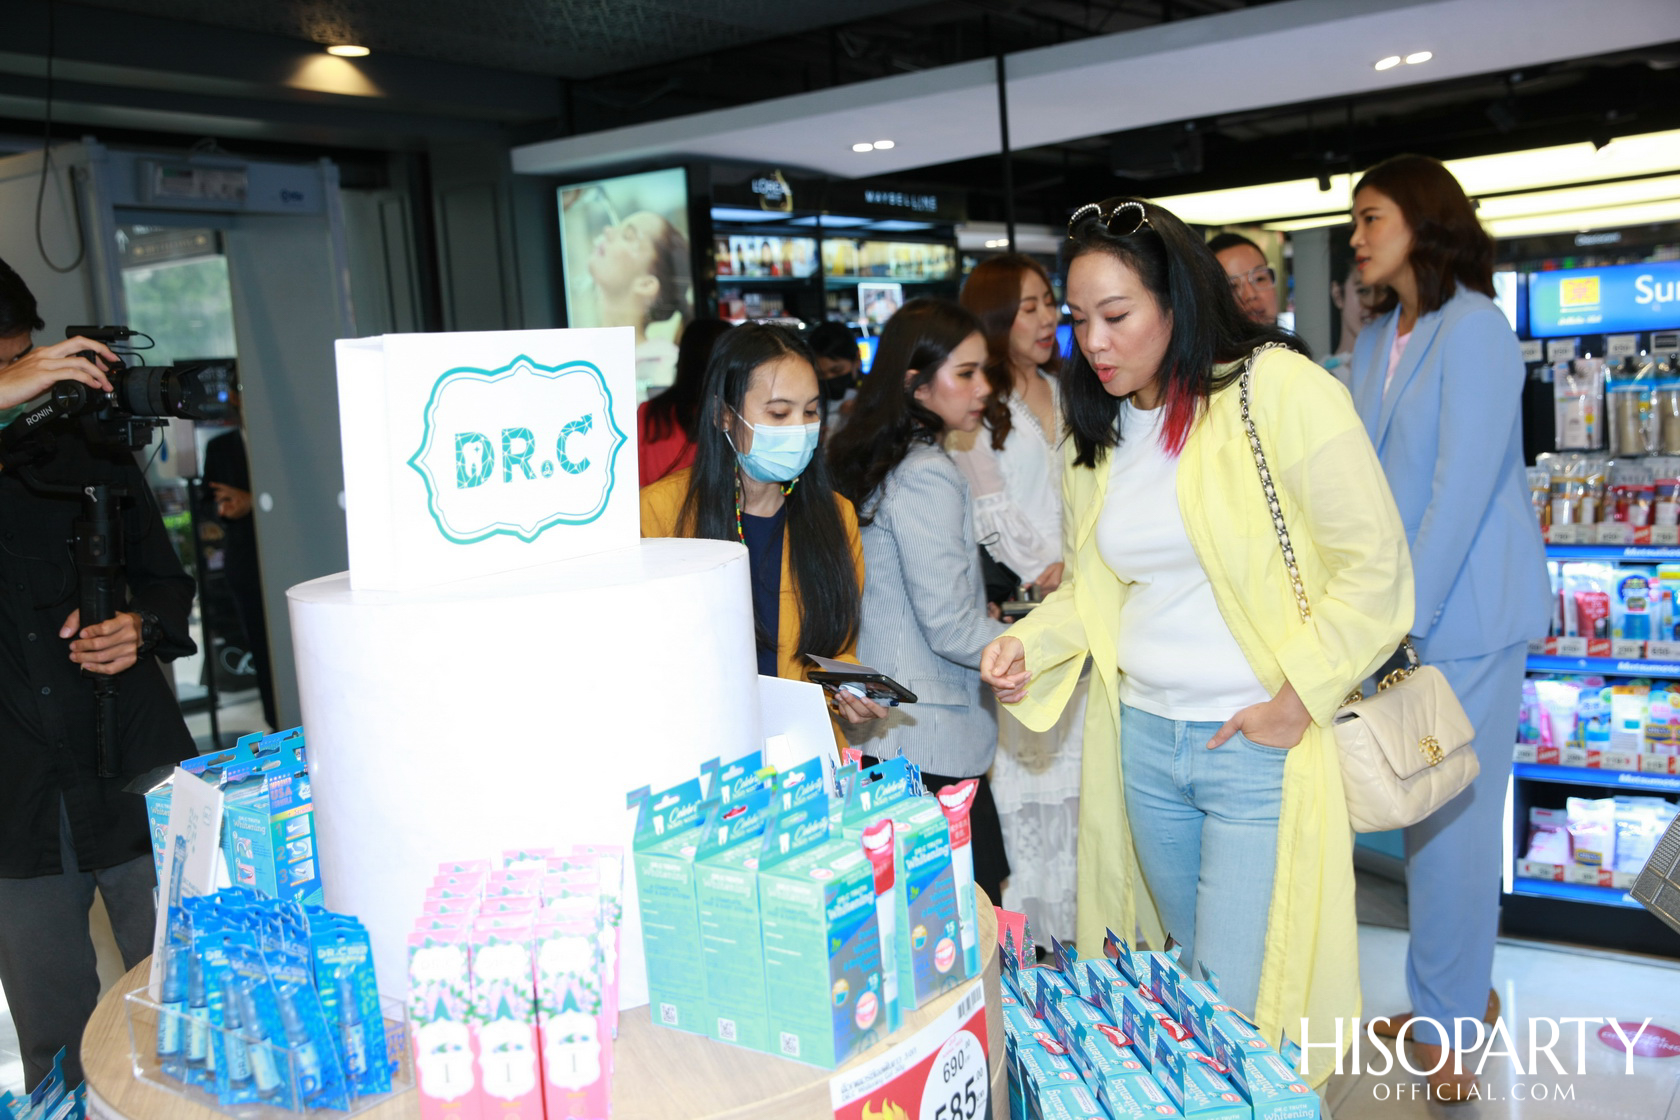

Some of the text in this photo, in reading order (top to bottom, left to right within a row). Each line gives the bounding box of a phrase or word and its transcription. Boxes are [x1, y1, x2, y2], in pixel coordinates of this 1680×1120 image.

[864, 190, 937, 209] MAYBELLINE
[25, 405, 54, 426] RONIN
[454, 412, 593, 490] DR.C
[271, 786, 293, 800] USA
[233, 820, 266, 836] Whitening
[905, 844, 950, 870] Whitening
[827, 891, 875, 921] Whitening
[943, 1049, 965, 1084] 690
[1021, 1048, 1048, 1085] Whitening
[1085, 1035, 1113, 1073] Whitening
[1245, 1057, 1279, 1098] Whitening
[1111, 1078, 1145, 1120] Whitening
[1288, 1103, 1307, 1111] TRUTH
